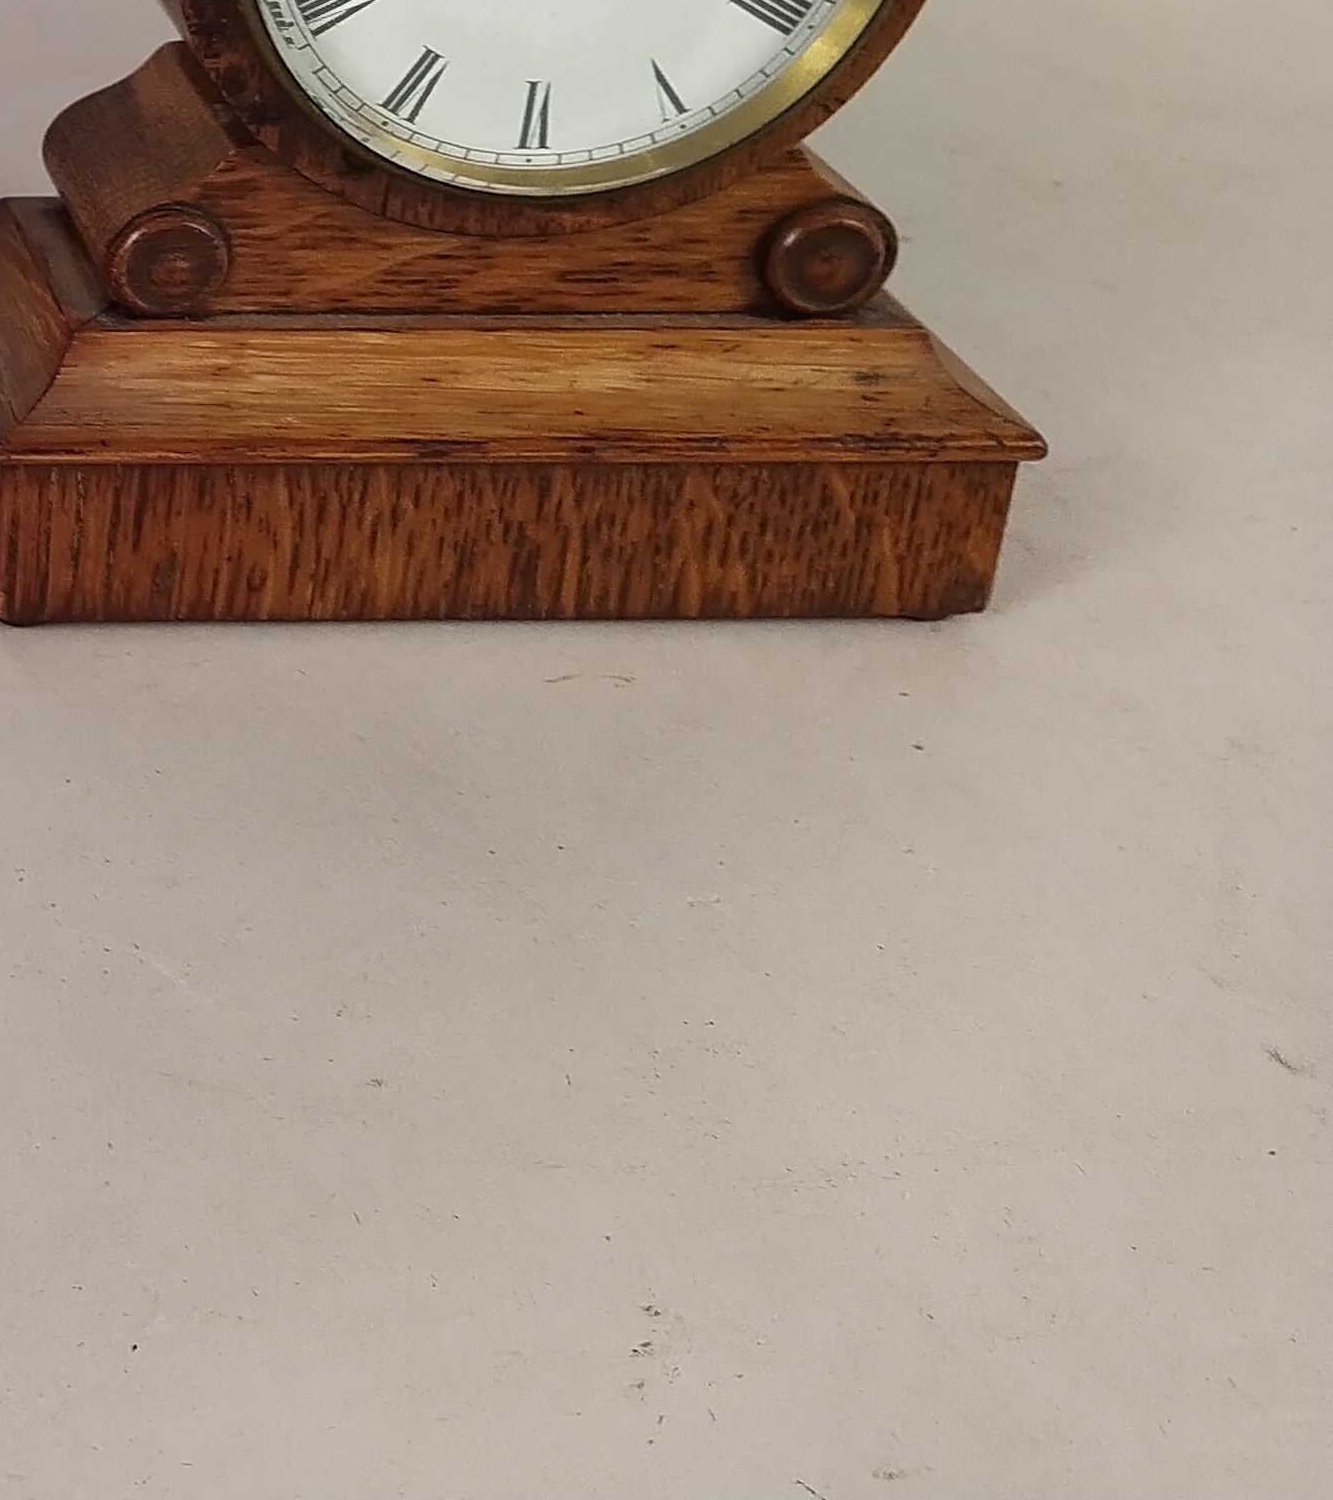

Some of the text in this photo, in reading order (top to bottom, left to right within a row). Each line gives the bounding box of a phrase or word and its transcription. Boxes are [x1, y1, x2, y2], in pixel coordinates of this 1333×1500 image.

[376, 45, 449, 124] VII
[514, 80, 550, 149] VI
[651, 58, 689, 121] V
